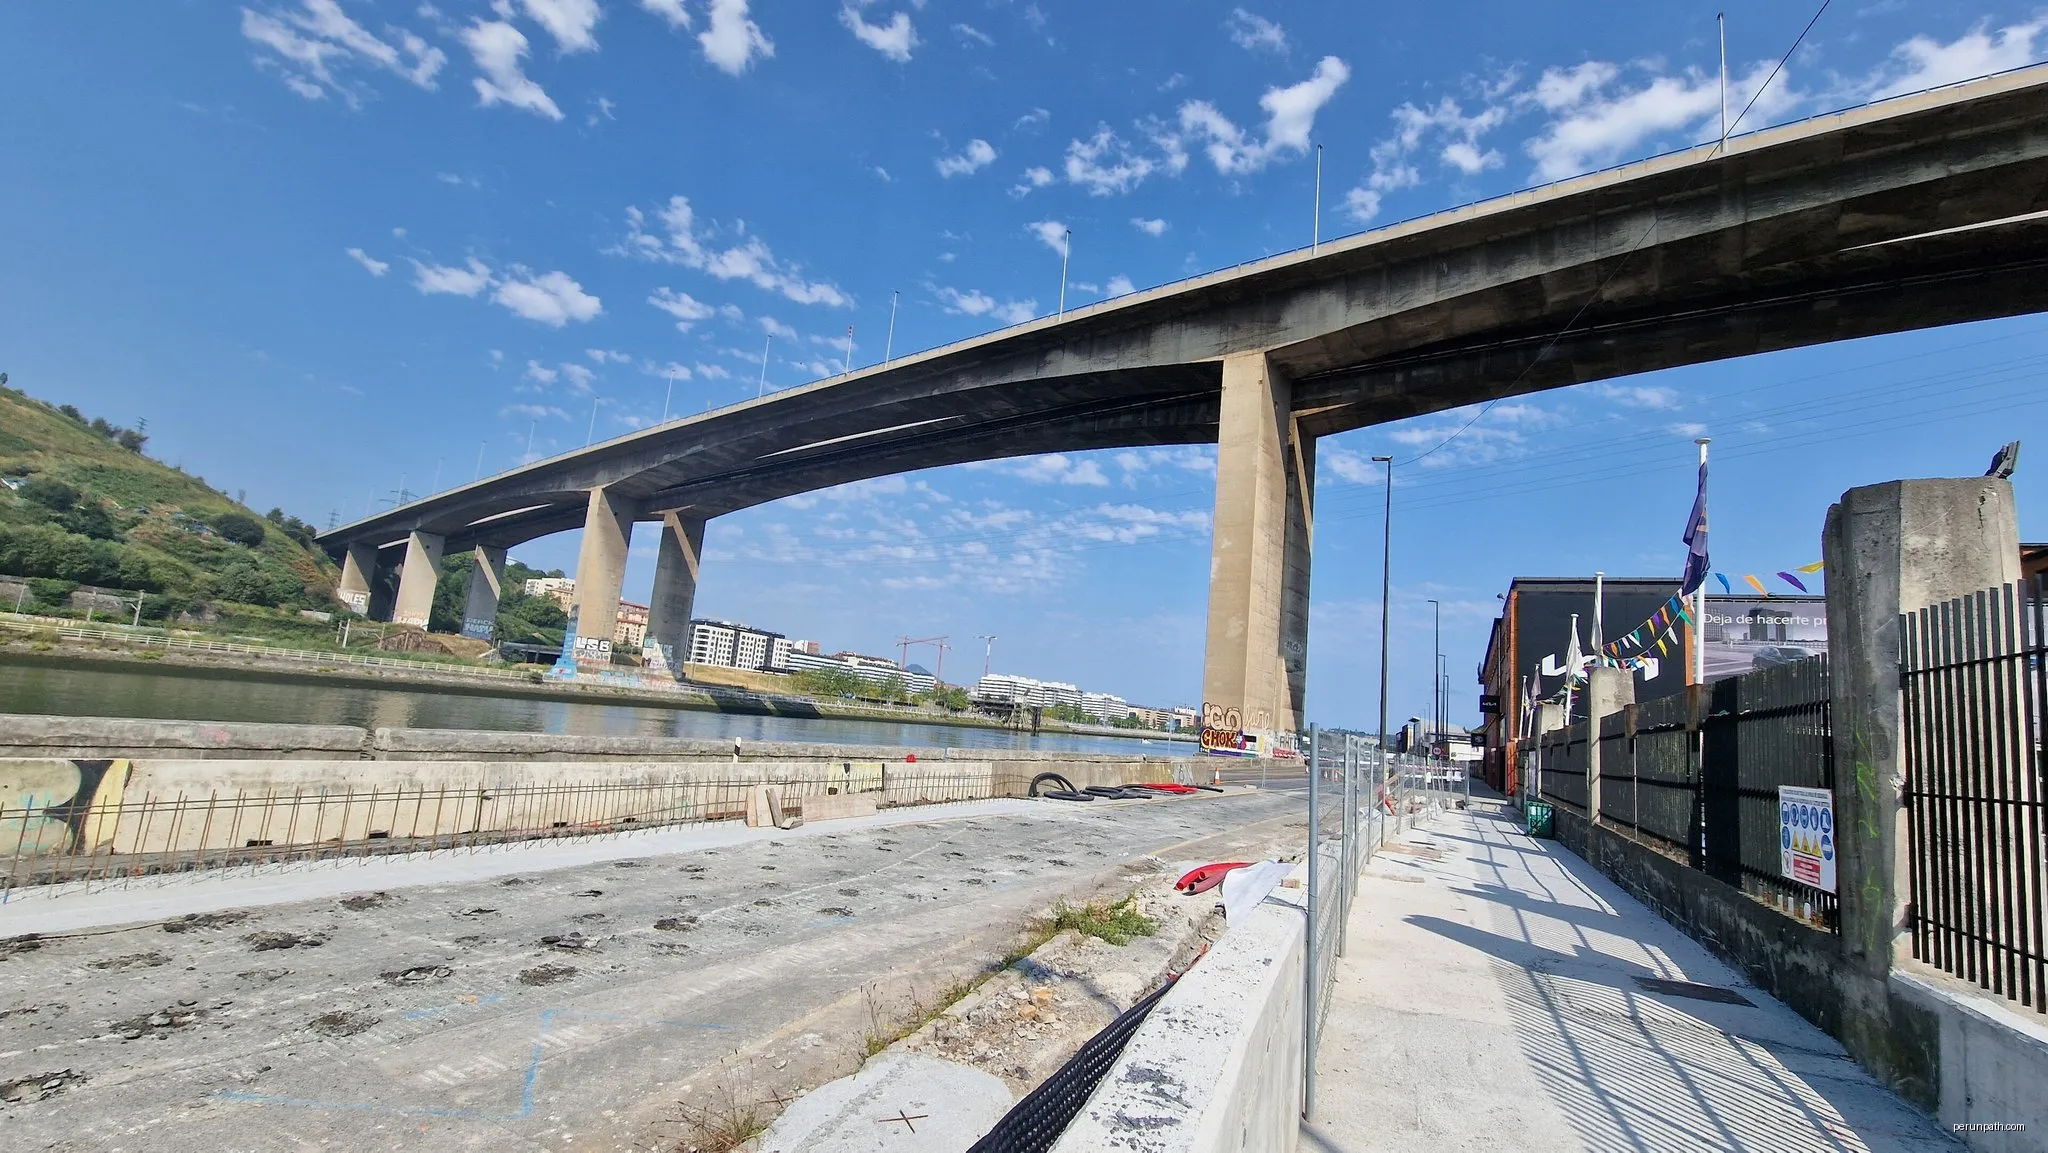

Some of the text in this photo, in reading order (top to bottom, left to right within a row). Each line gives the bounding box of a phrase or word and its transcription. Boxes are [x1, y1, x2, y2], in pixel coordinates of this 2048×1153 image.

[1704, 613, 1732, 625] Deja
[1736, 614, 1753, 625] de
[1757, 614, 1809, 626] hacerte
